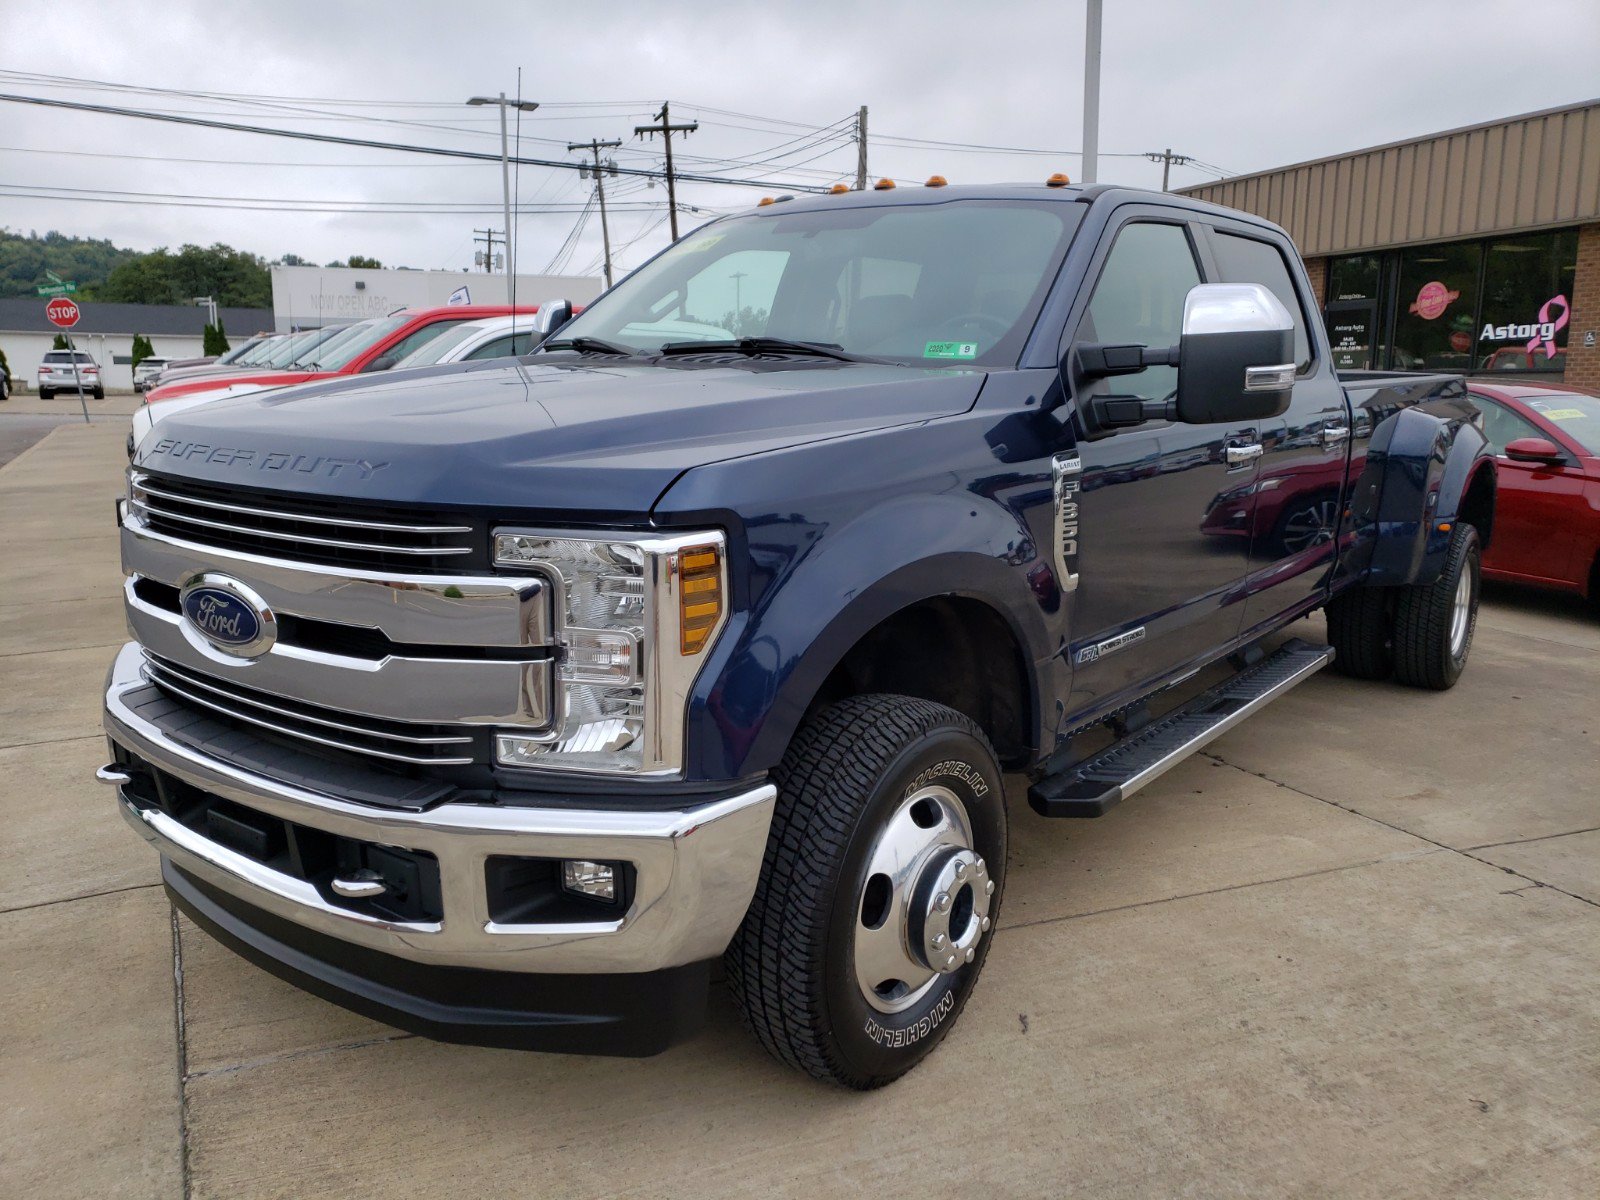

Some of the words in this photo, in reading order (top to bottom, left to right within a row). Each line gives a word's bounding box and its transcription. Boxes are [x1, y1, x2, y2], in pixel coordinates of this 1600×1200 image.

[49, 306, 77, 320] STOP
[311, 294, 335, 311] NOW
[337, 295, 365, 311] OPEN
[368, 296, 388, 311] ABC
[1480, 322, 1555, 341] Astorg
[964, 345, 971, 353] 9
[152, 438, 254, 466] SUPER
[260, 452, 392, 481] DUTY
[1060, 461, 1080, 470] LARIAT
[196, 594, 241, 637] Ford
[1100, 638, 1122, 652] POWER
[1122, 628, 1145, 643] STROKE
[905, 760, 989, 798] MICHELIN
[865, 989, 955, 1048] MICHELIN
